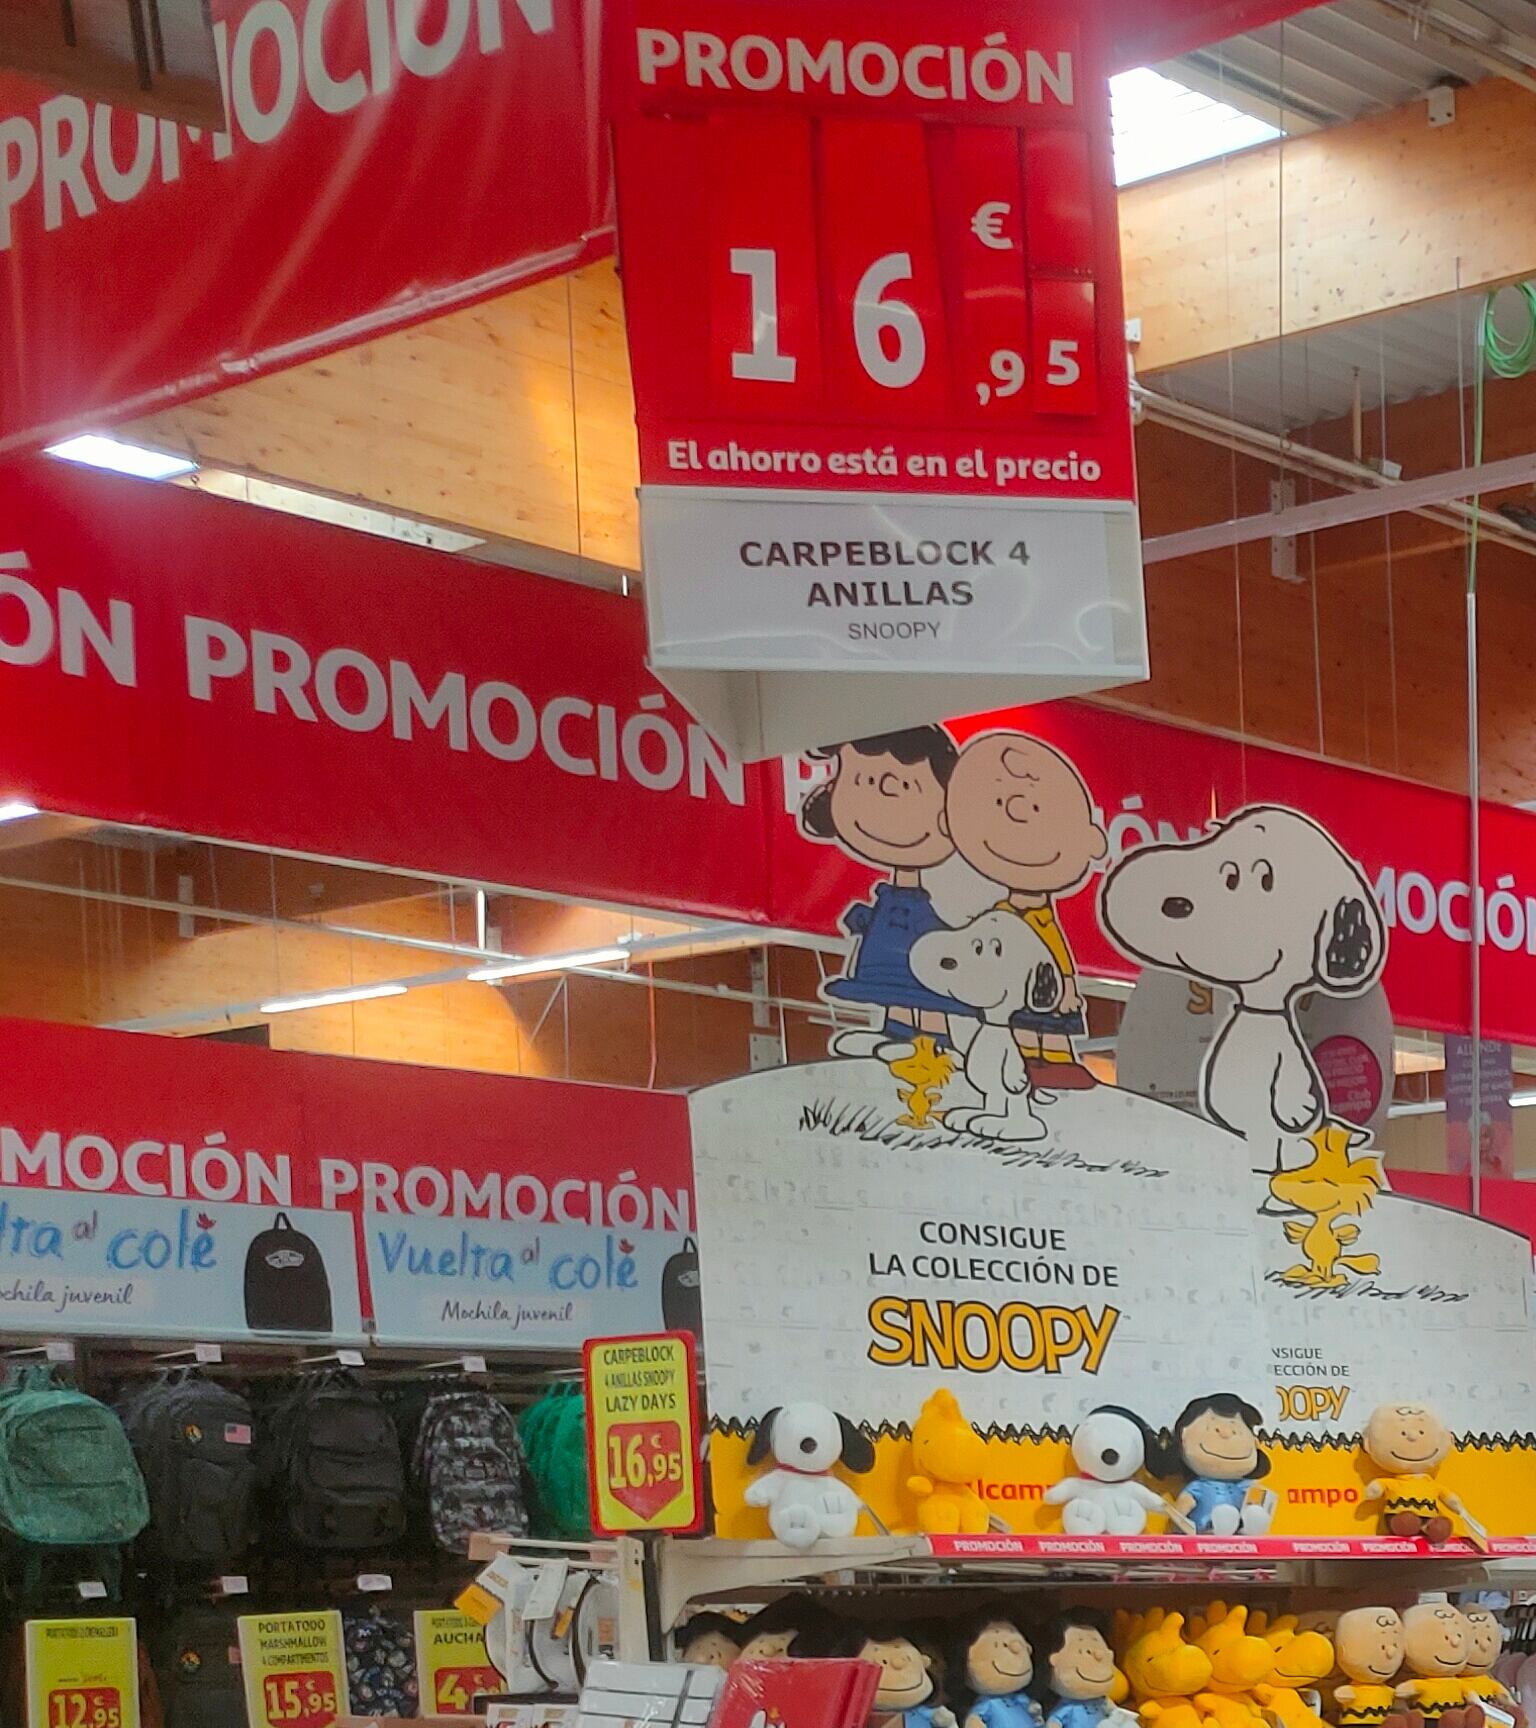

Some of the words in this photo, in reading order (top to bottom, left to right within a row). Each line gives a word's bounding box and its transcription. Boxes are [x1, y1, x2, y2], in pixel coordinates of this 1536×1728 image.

[636, 27, 1075, 105] PROMOCIÓN
[668, 440, 701, 471] El
[708, 442, 822, 474] ahorro
[827, 446, 899, 477] está
[907, 456, 948, 478] en
[955, 449, 986, 479] el
[995, 451, 1102, 487] precio
[740, 540, 995, 567] CARPEBLOCK
[1009, 541, 1031, 566] 4
[807, 580, 974, 608] ANILLAS
[848, 621, 942, 642] SNOOPY
[183, 614, 746, 806] PROMOCIÓN
[321, 1159, 690, 1232] PROMOCIÓN
[919, 1221, 1067, 1252] CONSIGUE
[378, 1231, 514, 1280] Vuelta
[869, 1253, 906, 1278] LA
[911, 1253, 1075, 1286] COLECCIÓN
[1083, 1264, 1119, 1288] DE
[56, 1284, 134, 1308] juvenil
[441, 1300, 507, 1322] Mochila
[513, 1300, 573, 1324] juvenil
[867, 1295, 1121, 1375] SNOOPY
[603, 1346, 674, 1365] CARPEBLOCK
[606, 1396, 638, 1412] LAZY
[642, 1393, 676, 1410] DAYS
[259, 1621, 326, 1634] PORTATODO
